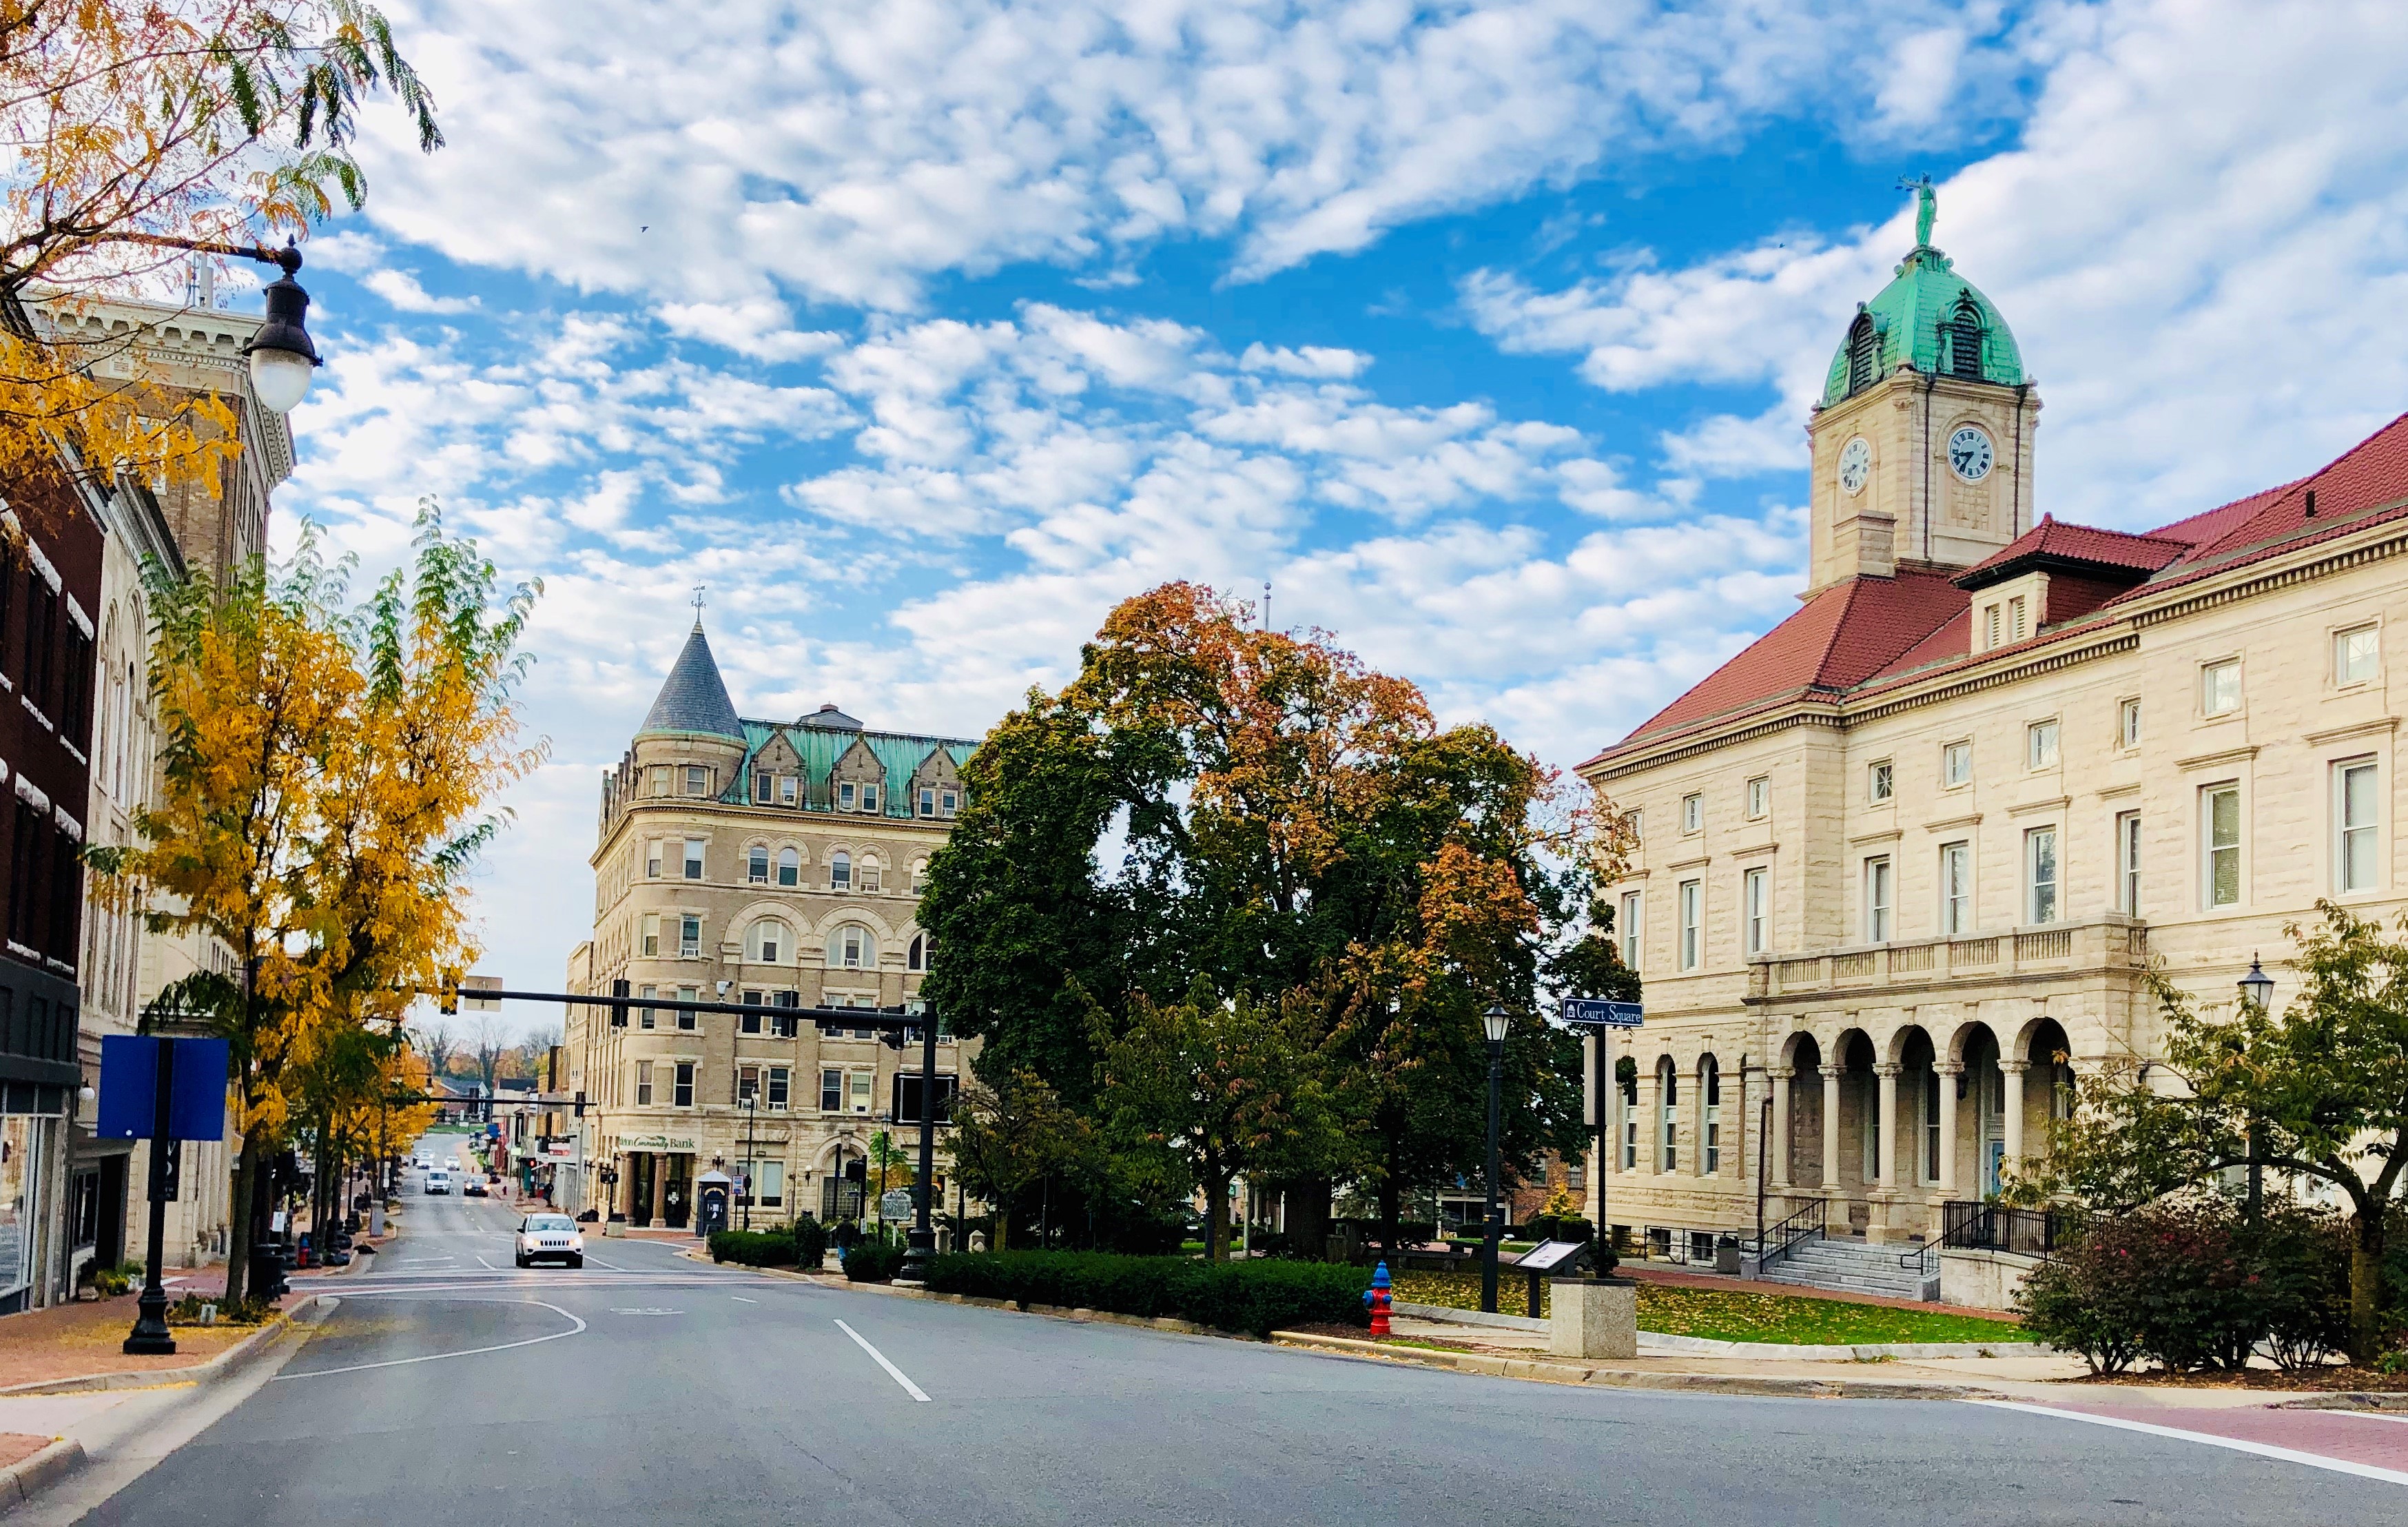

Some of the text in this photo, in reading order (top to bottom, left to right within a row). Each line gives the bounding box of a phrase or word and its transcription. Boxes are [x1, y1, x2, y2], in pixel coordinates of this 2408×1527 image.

[1577, 1002, 1641, 1023] Court Square
[634, 1136, 669, 1151] Community
[670, 1138, 695, 1149] Bank
